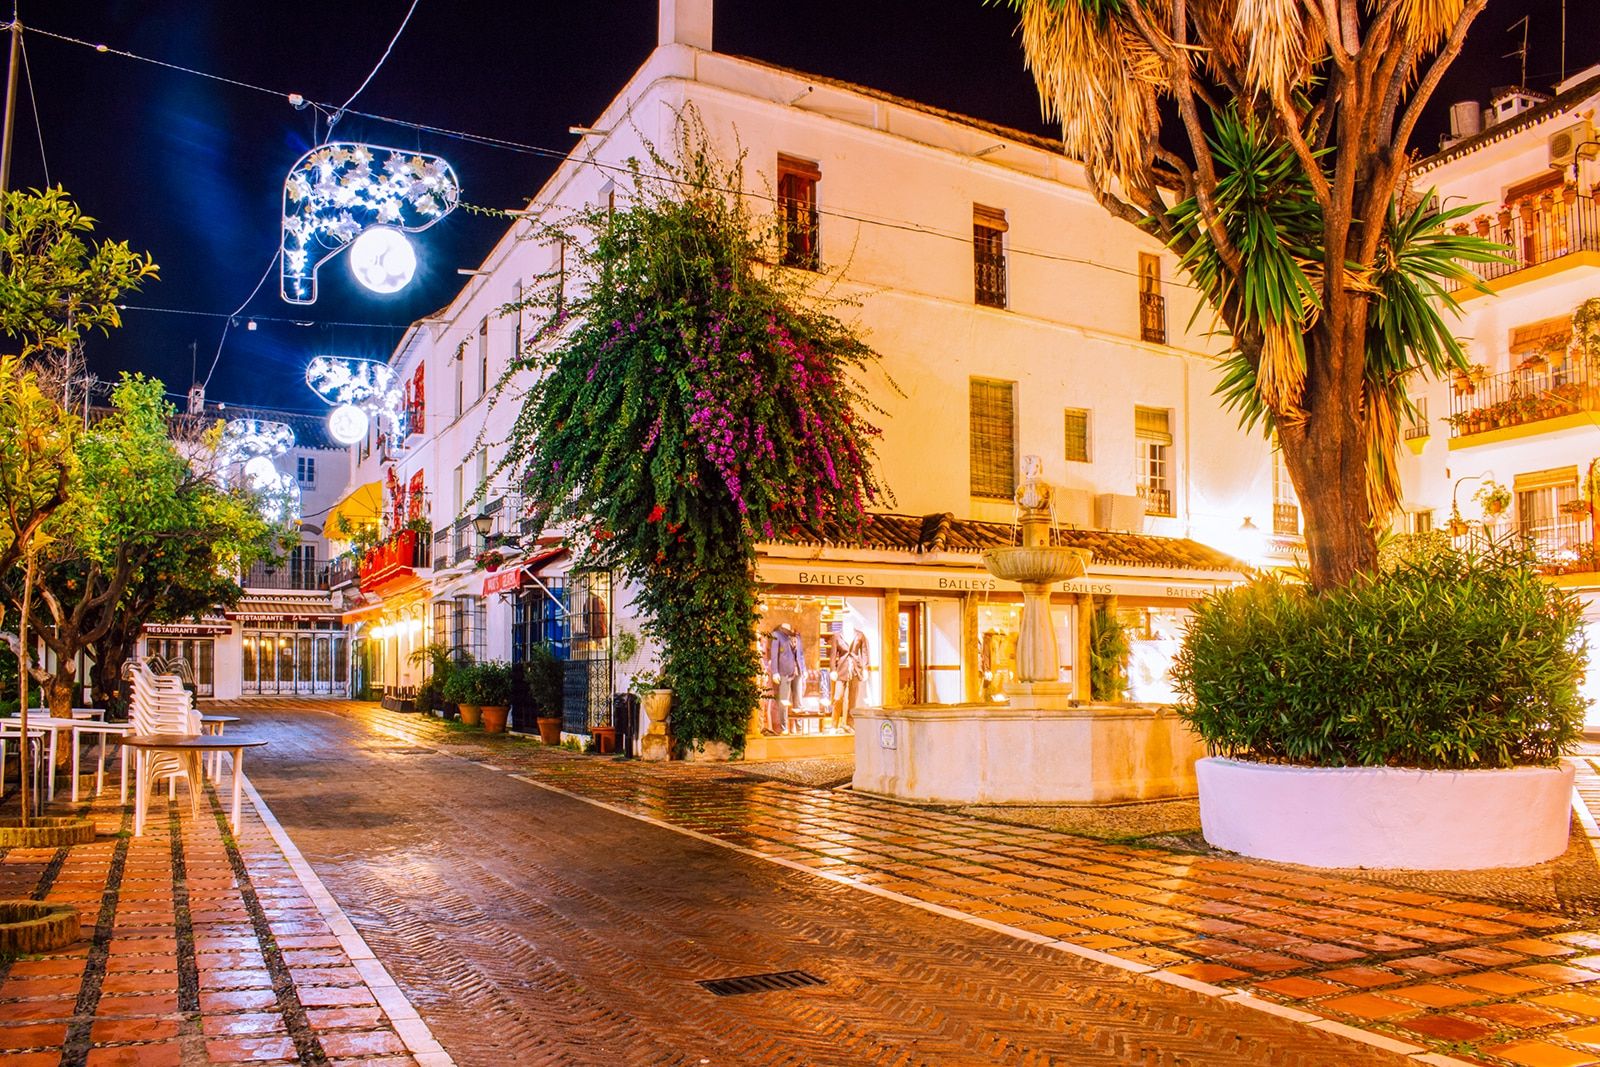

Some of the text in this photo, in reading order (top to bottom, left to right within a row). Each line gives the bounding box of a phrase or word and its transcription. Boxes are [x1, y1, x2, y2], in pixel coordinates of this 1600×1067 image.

[799, 572, 865, 585] BAILEYS
[939, 577, 996, 590] BAILEYS
[1063, 582, 1112, 593] BAILEYS
[146, 627, 198, 635] RESTAURANTE
